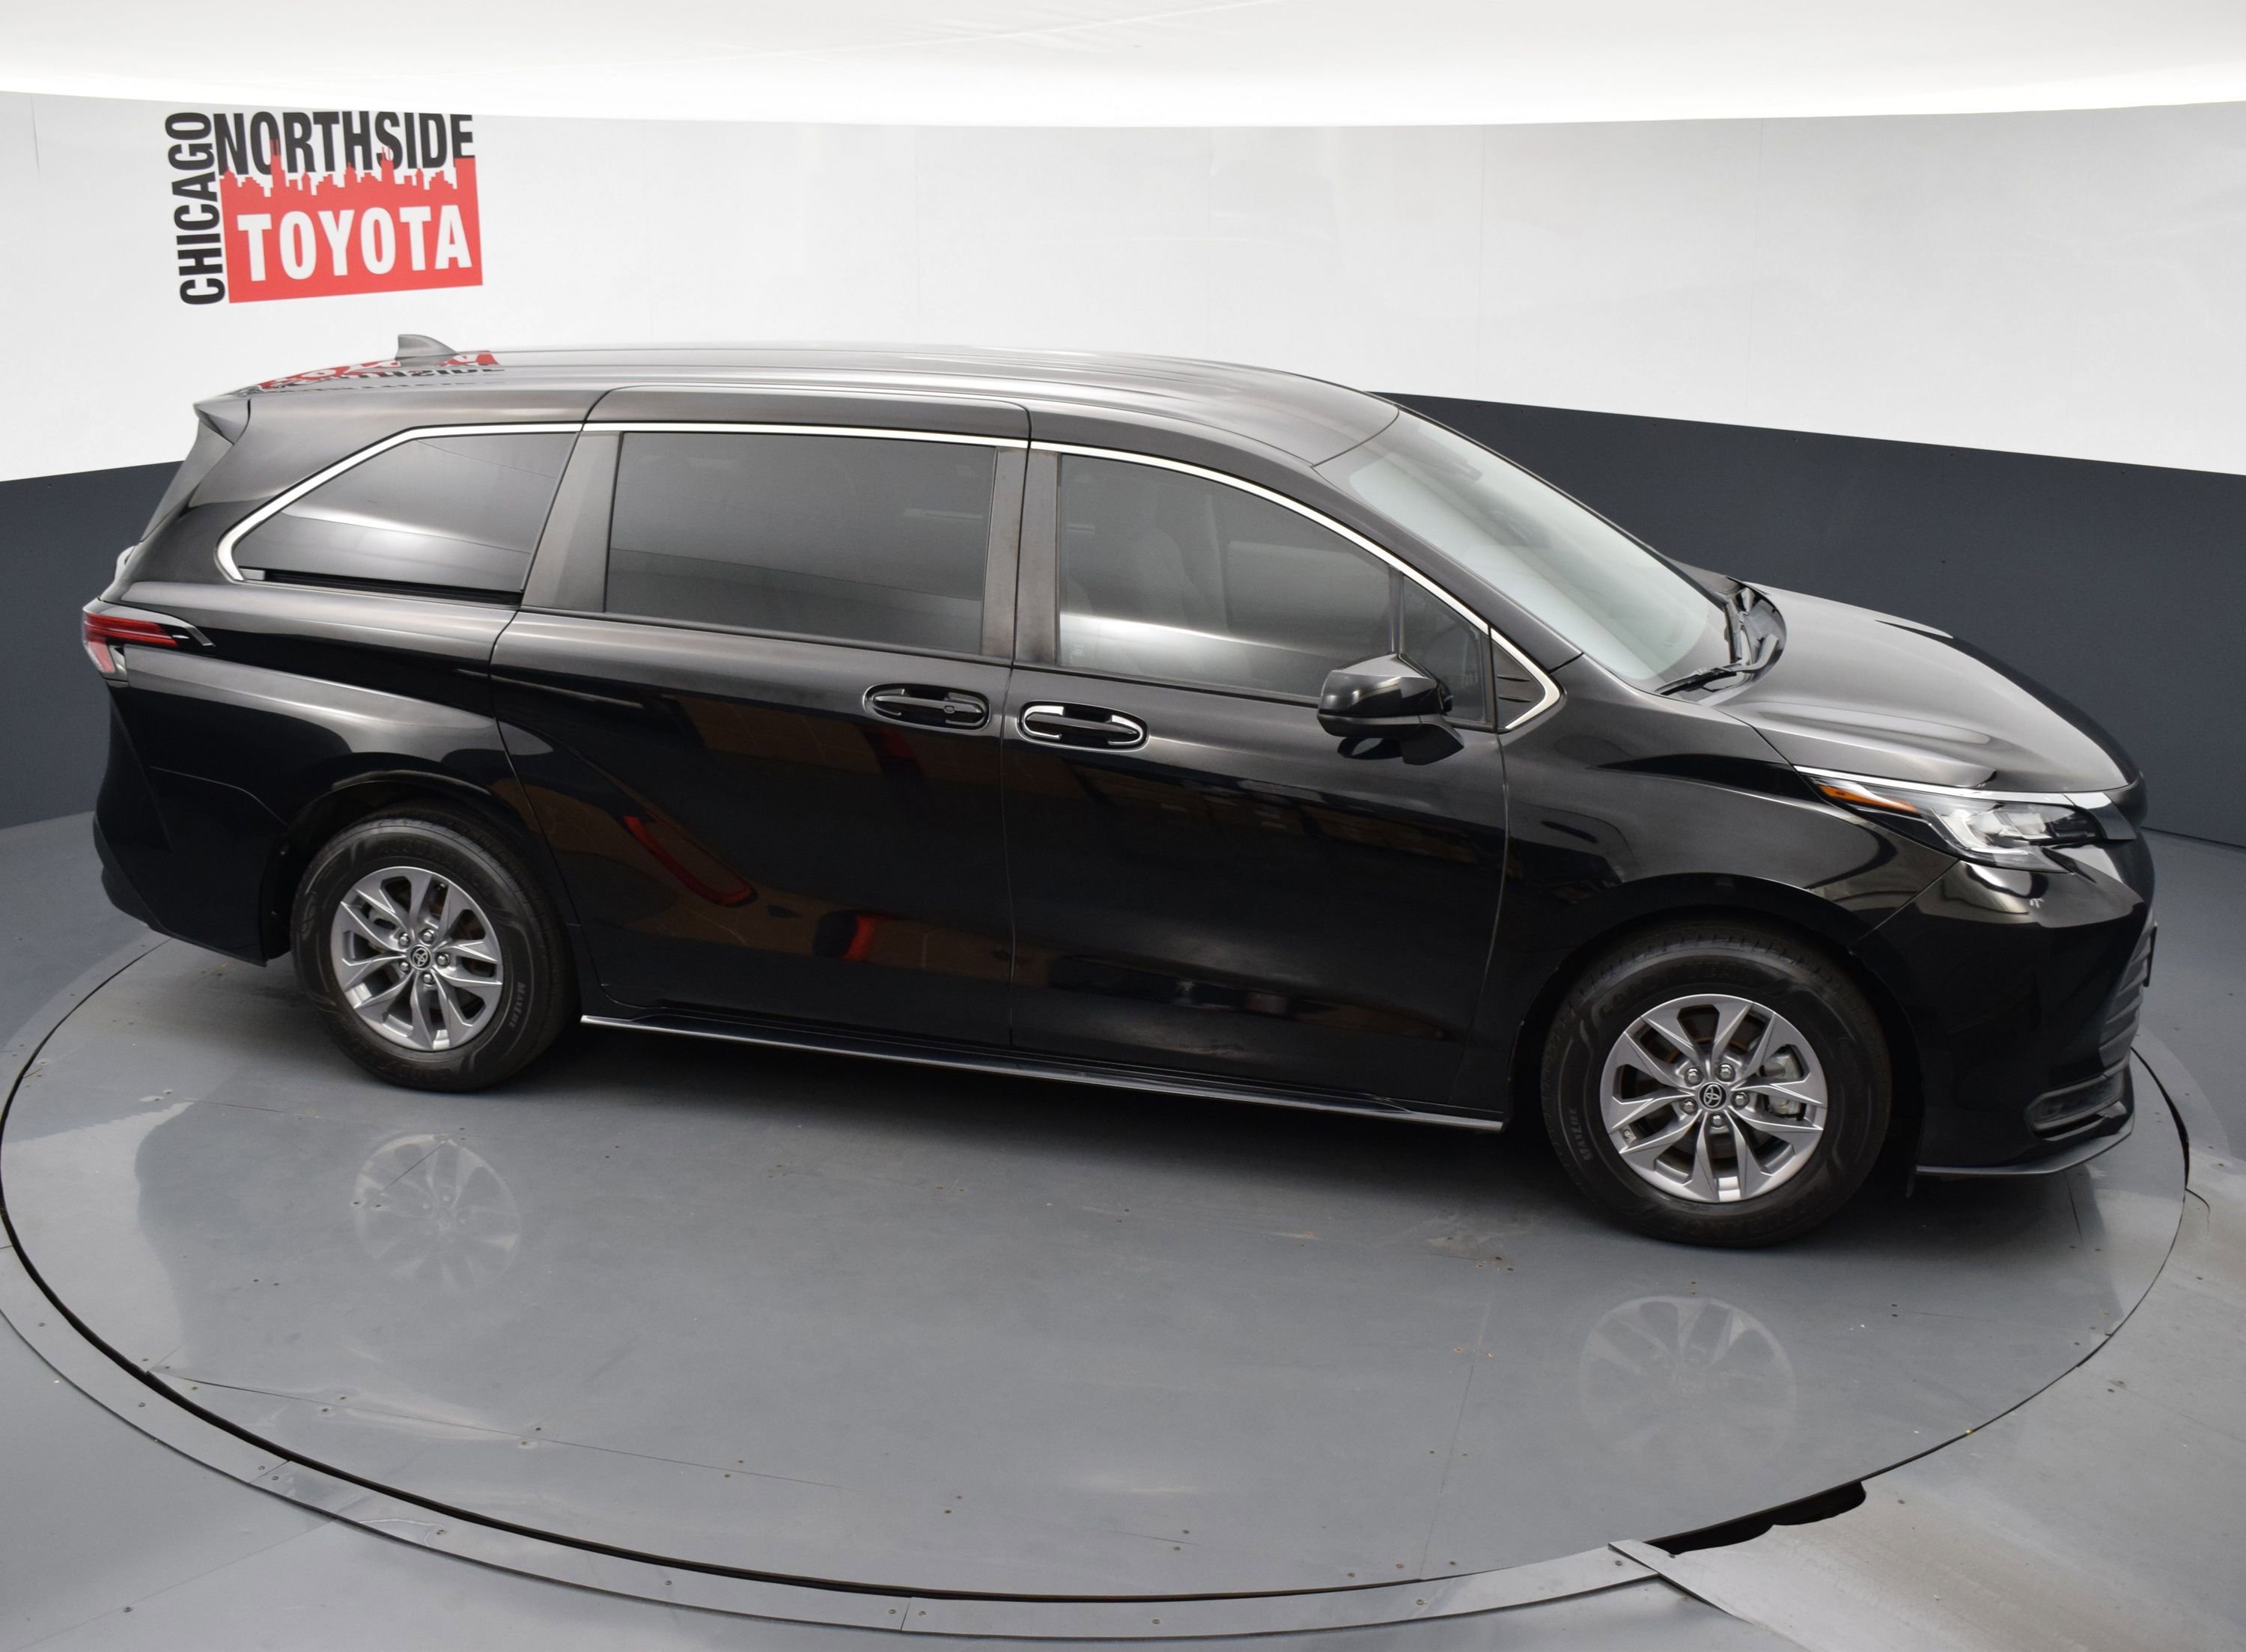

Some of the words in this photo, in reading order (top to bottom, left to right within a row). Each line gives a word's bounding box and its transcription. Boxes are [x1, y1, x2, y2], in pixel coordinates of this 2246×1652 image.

[213, 111, 475, 176] NORTHSIDE
[165, 112, 225, 305] CHICAGO
[237, 204, 472, 281] TOYOTA
